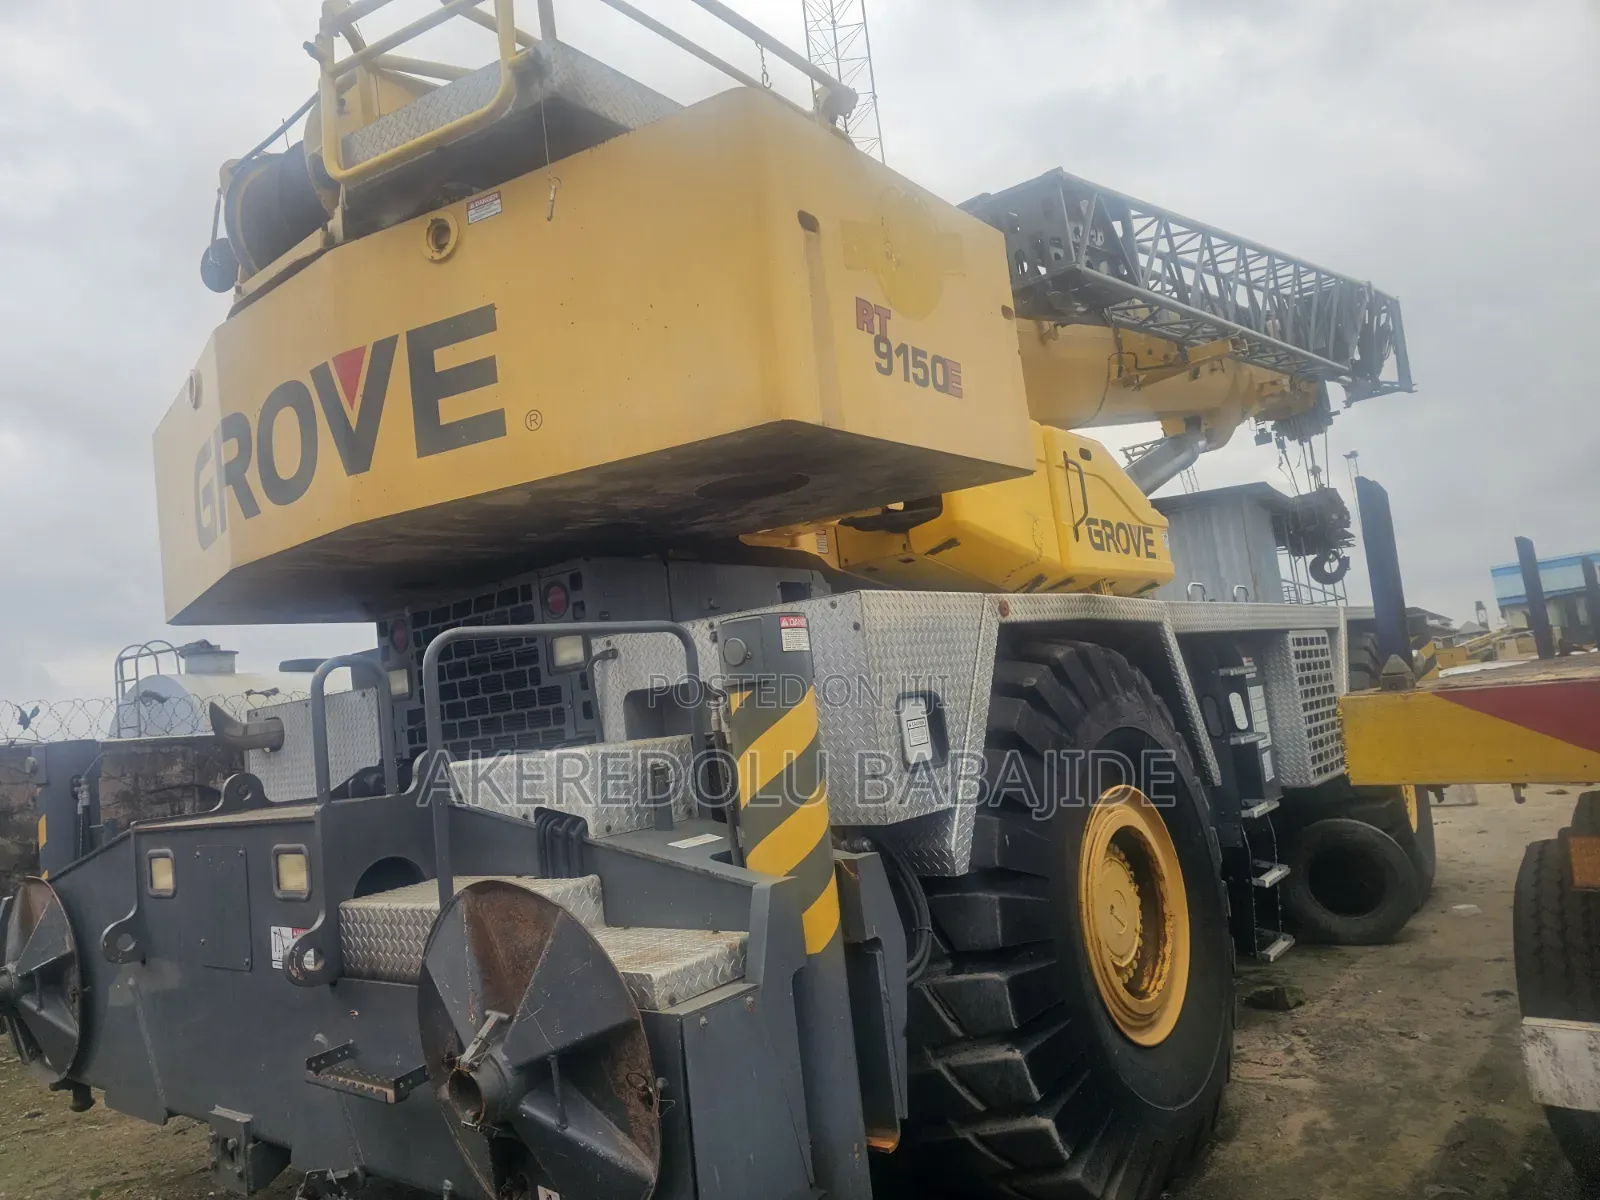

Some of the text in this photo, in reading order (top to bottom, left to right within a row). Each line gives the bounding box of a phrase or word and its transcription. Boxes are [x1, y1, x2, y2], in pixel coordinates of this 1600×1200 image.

[855, 296, 892, 342] RT
[873, 333, 964, 400] 9150E
[193, 302, 508, 551] GROVE
[1085, 517, 1157, 559] GROVE
